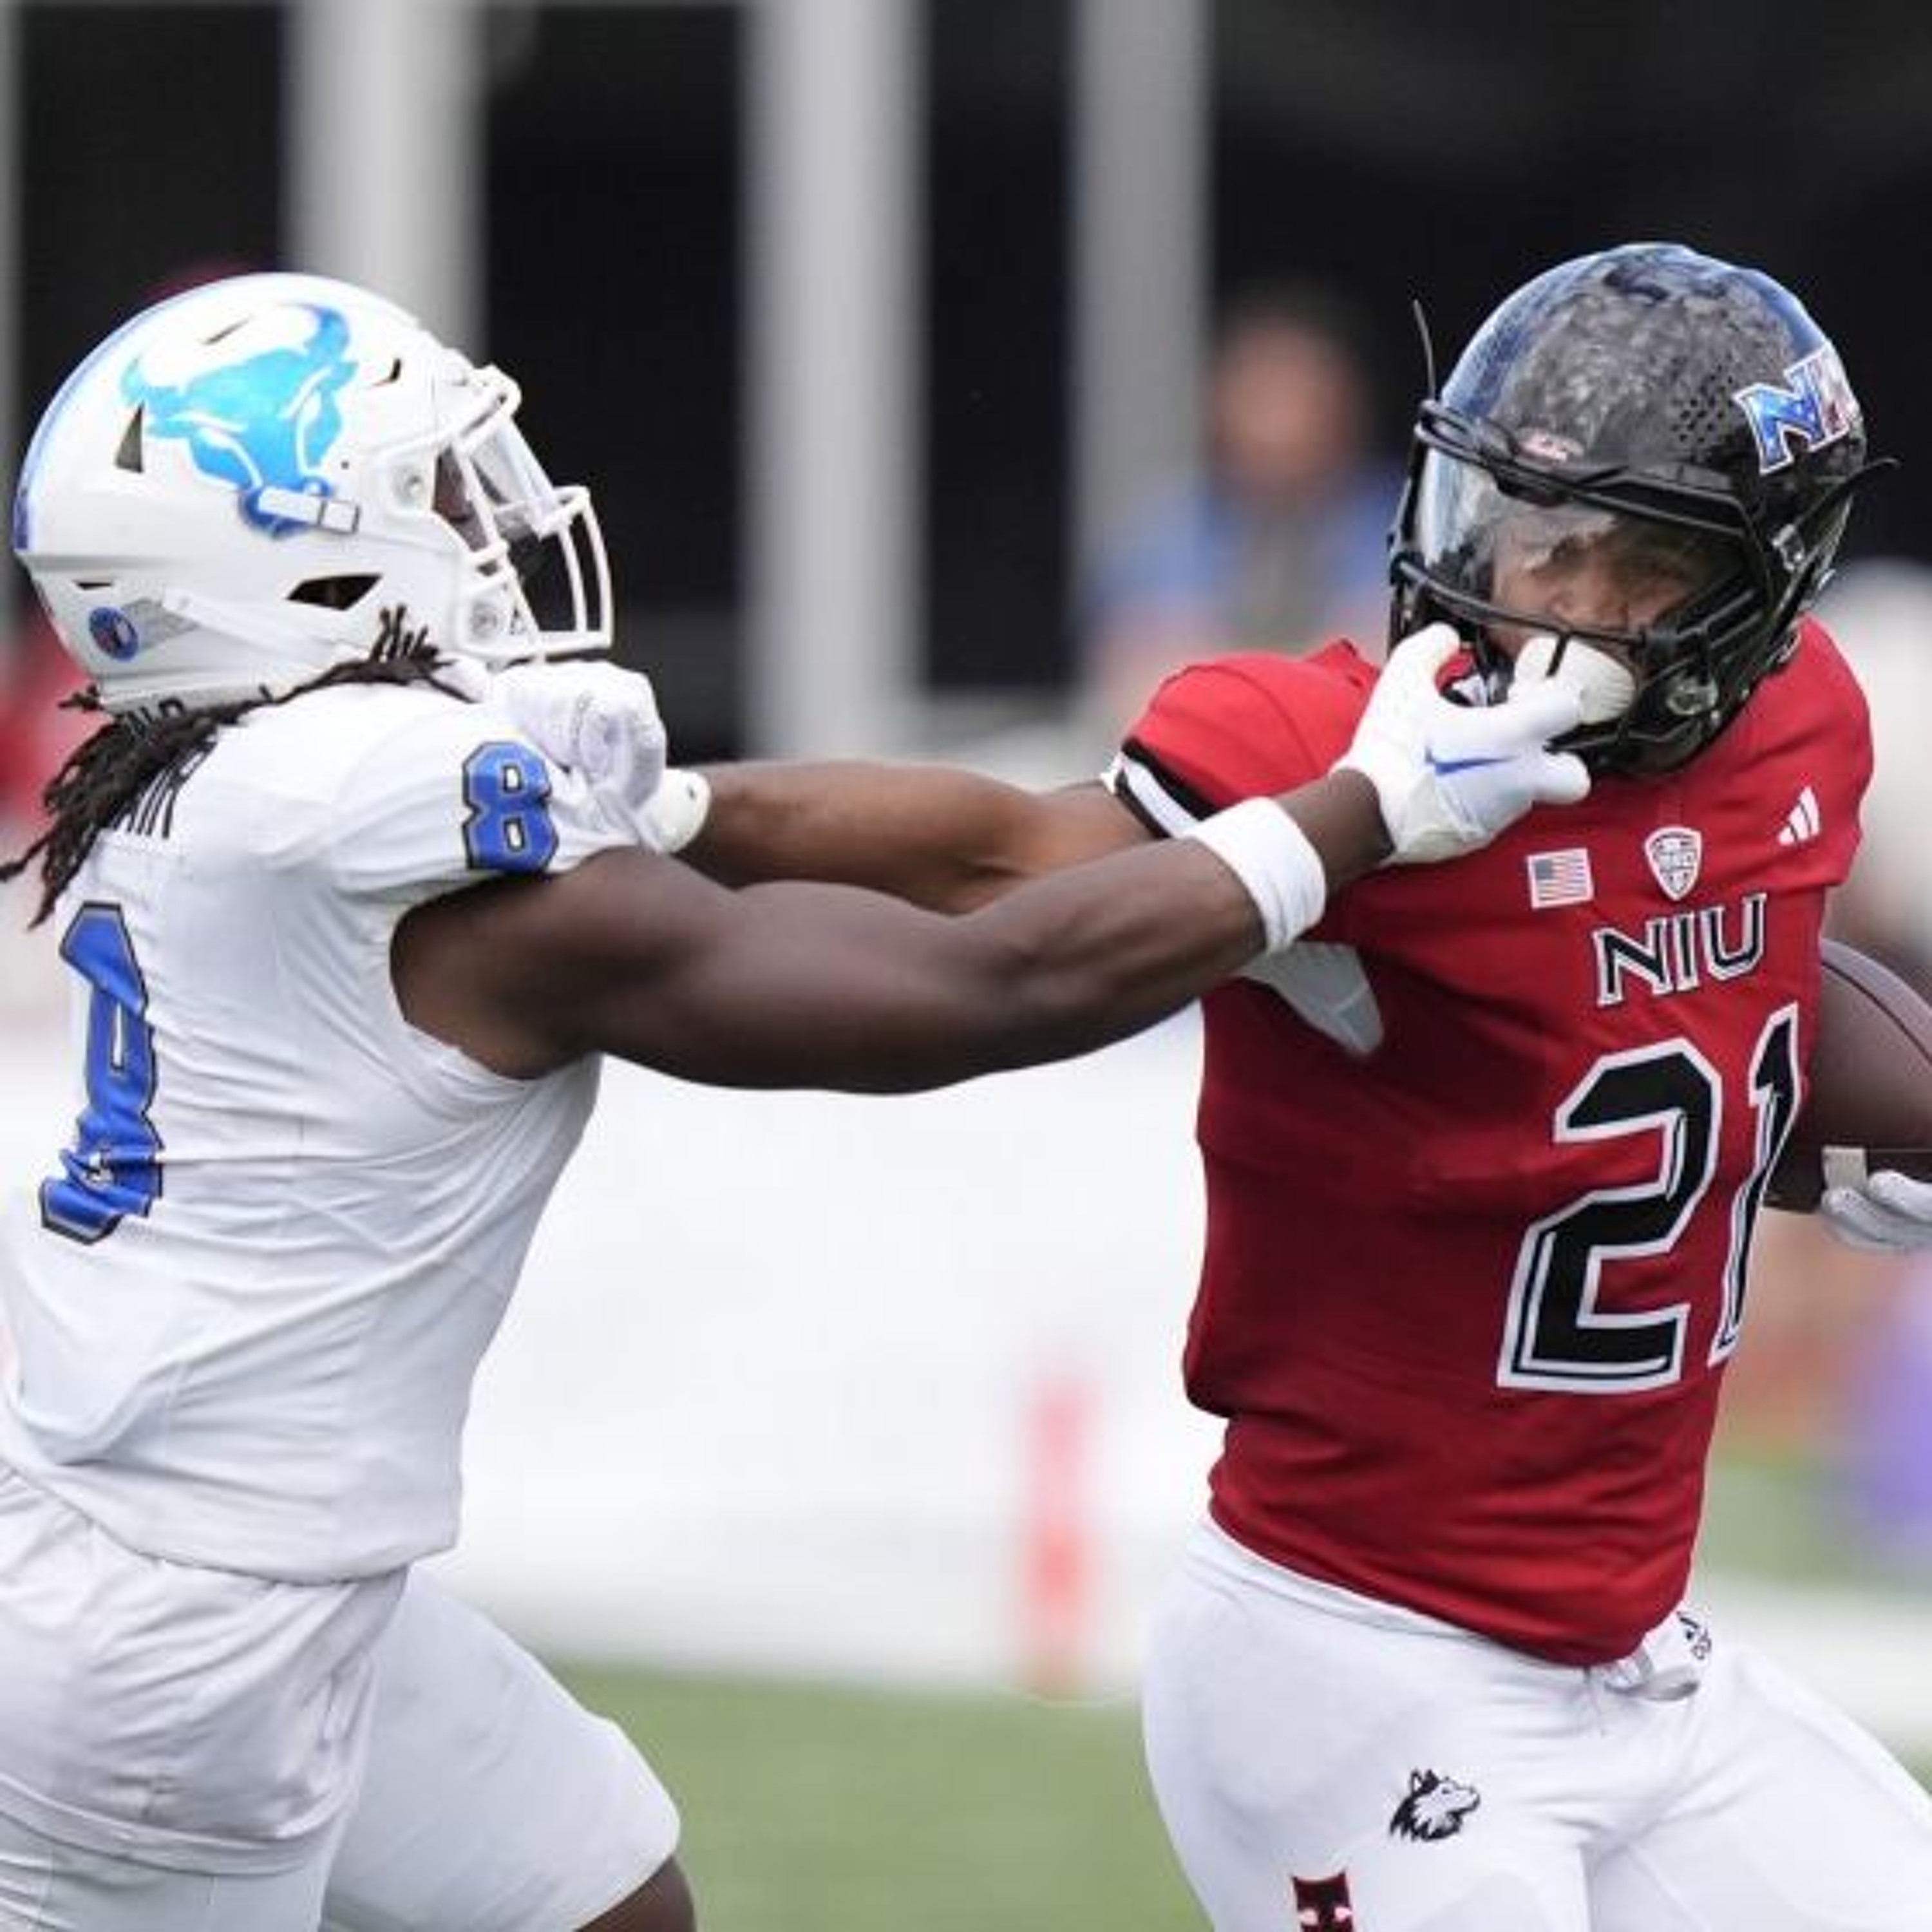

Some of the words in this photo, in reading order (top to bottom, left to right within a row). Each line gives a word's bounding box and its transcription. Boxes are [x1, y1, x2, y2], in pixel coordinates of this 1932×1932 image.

[461, 741, 560, 872] 8
[1592, 893, 1768, 1007] NIU
[1495, 1001, 1801, 1396] 21
